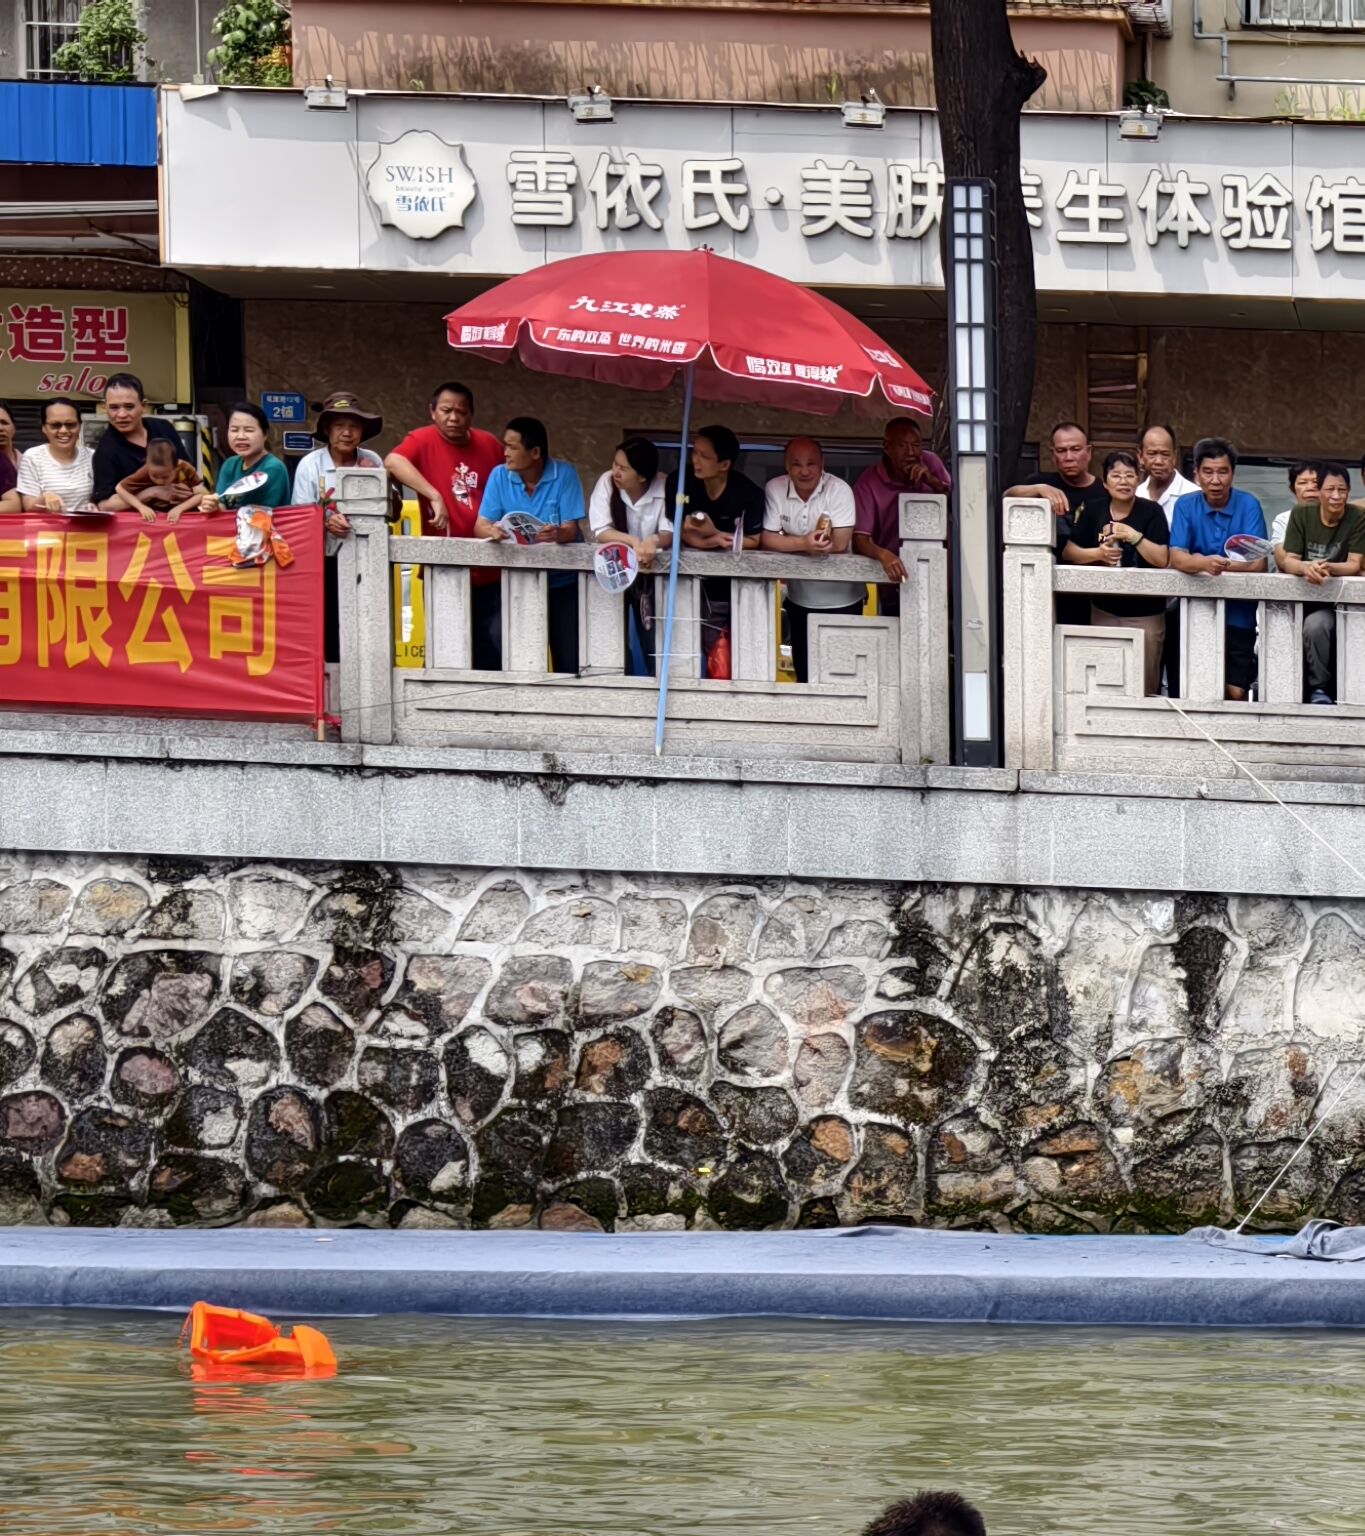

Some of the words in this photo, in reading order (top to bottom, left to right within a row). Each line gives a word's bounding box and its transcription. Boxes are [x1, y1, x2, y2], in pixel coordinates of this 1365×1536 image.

[396, 195, 447, 212] 雪依氏
[0, 304, 130, 364] 造型
[38, 366, 107, 393] salo
